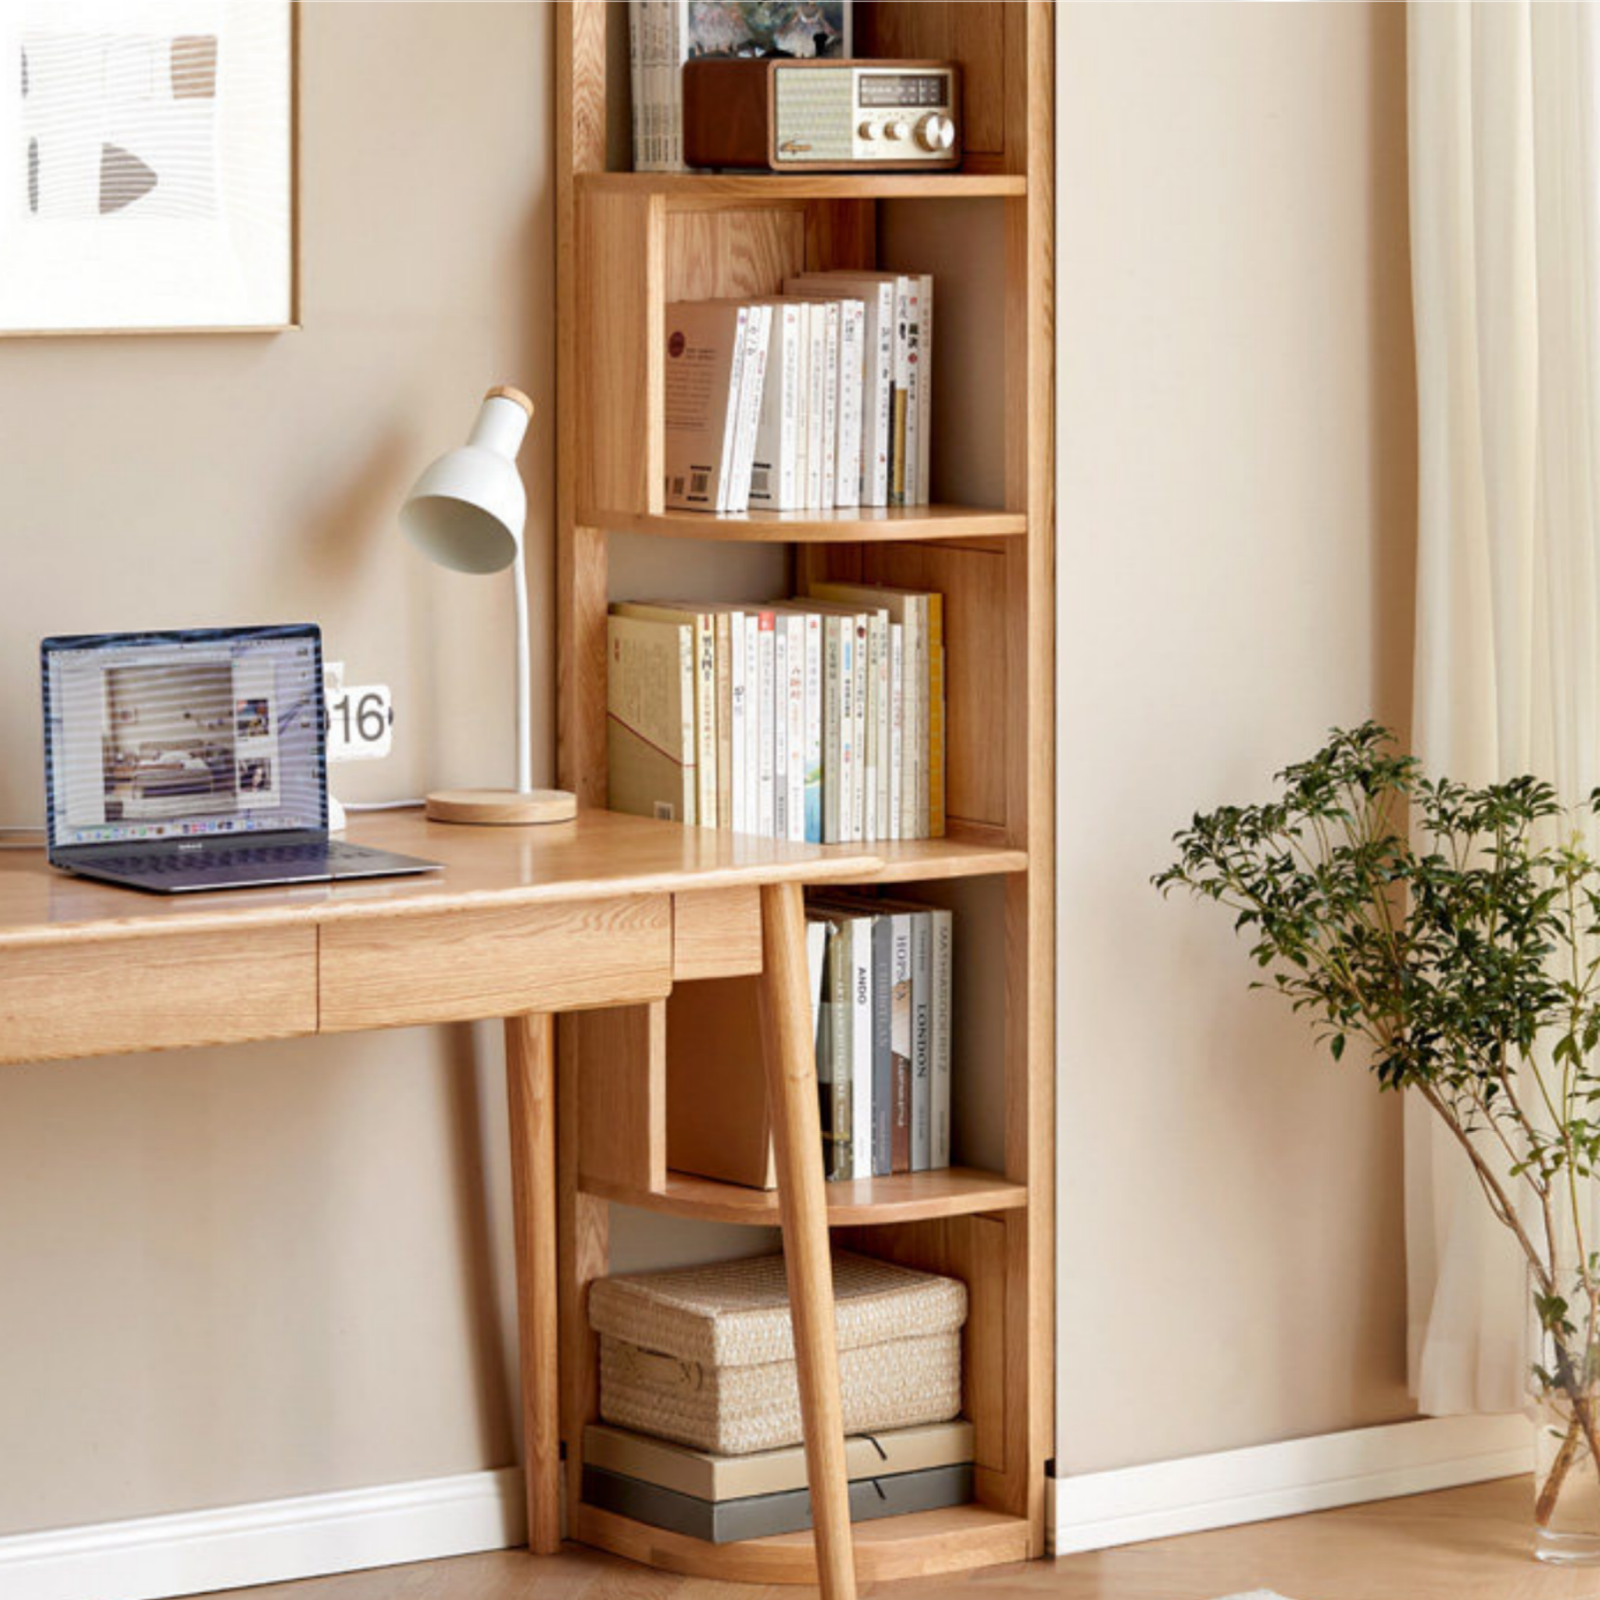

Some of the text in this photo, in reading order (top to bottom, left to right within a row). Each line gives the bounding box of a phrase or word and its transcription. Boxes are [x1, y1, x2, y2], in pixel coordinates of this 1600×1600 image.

[333, 693, 385, 743] 16
[857, 966, 867, 1005] ANDO
[917, 1004, 927, 1078] LONDON
